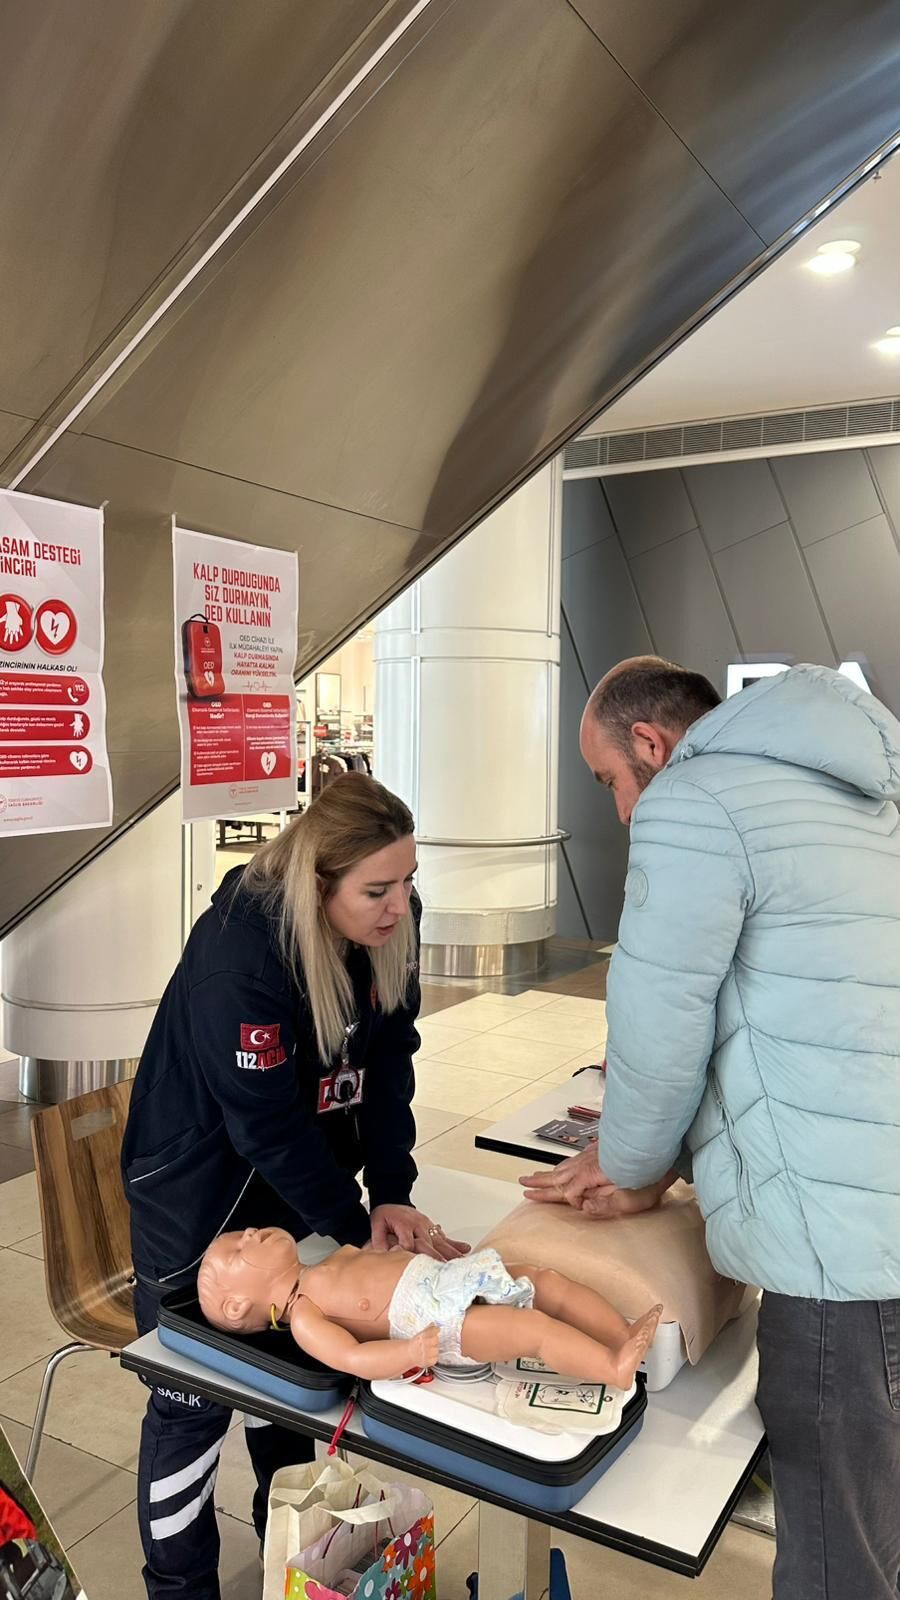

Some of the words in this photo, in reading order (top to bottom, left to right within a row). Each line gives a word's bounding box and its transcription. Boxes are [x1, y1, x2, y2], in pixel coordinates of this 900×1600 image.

[193, 563, 219, 582] KALP
[205, 585, 220, 602] SİZ
[223, 587, 272, 612] DURMAYIN,
[205, 605, 223, 623] OED
[226, 607, 272, 628] KULLANIN
[234, 651, 248, 660] KALP
[74, 683, 84, 692] 112
